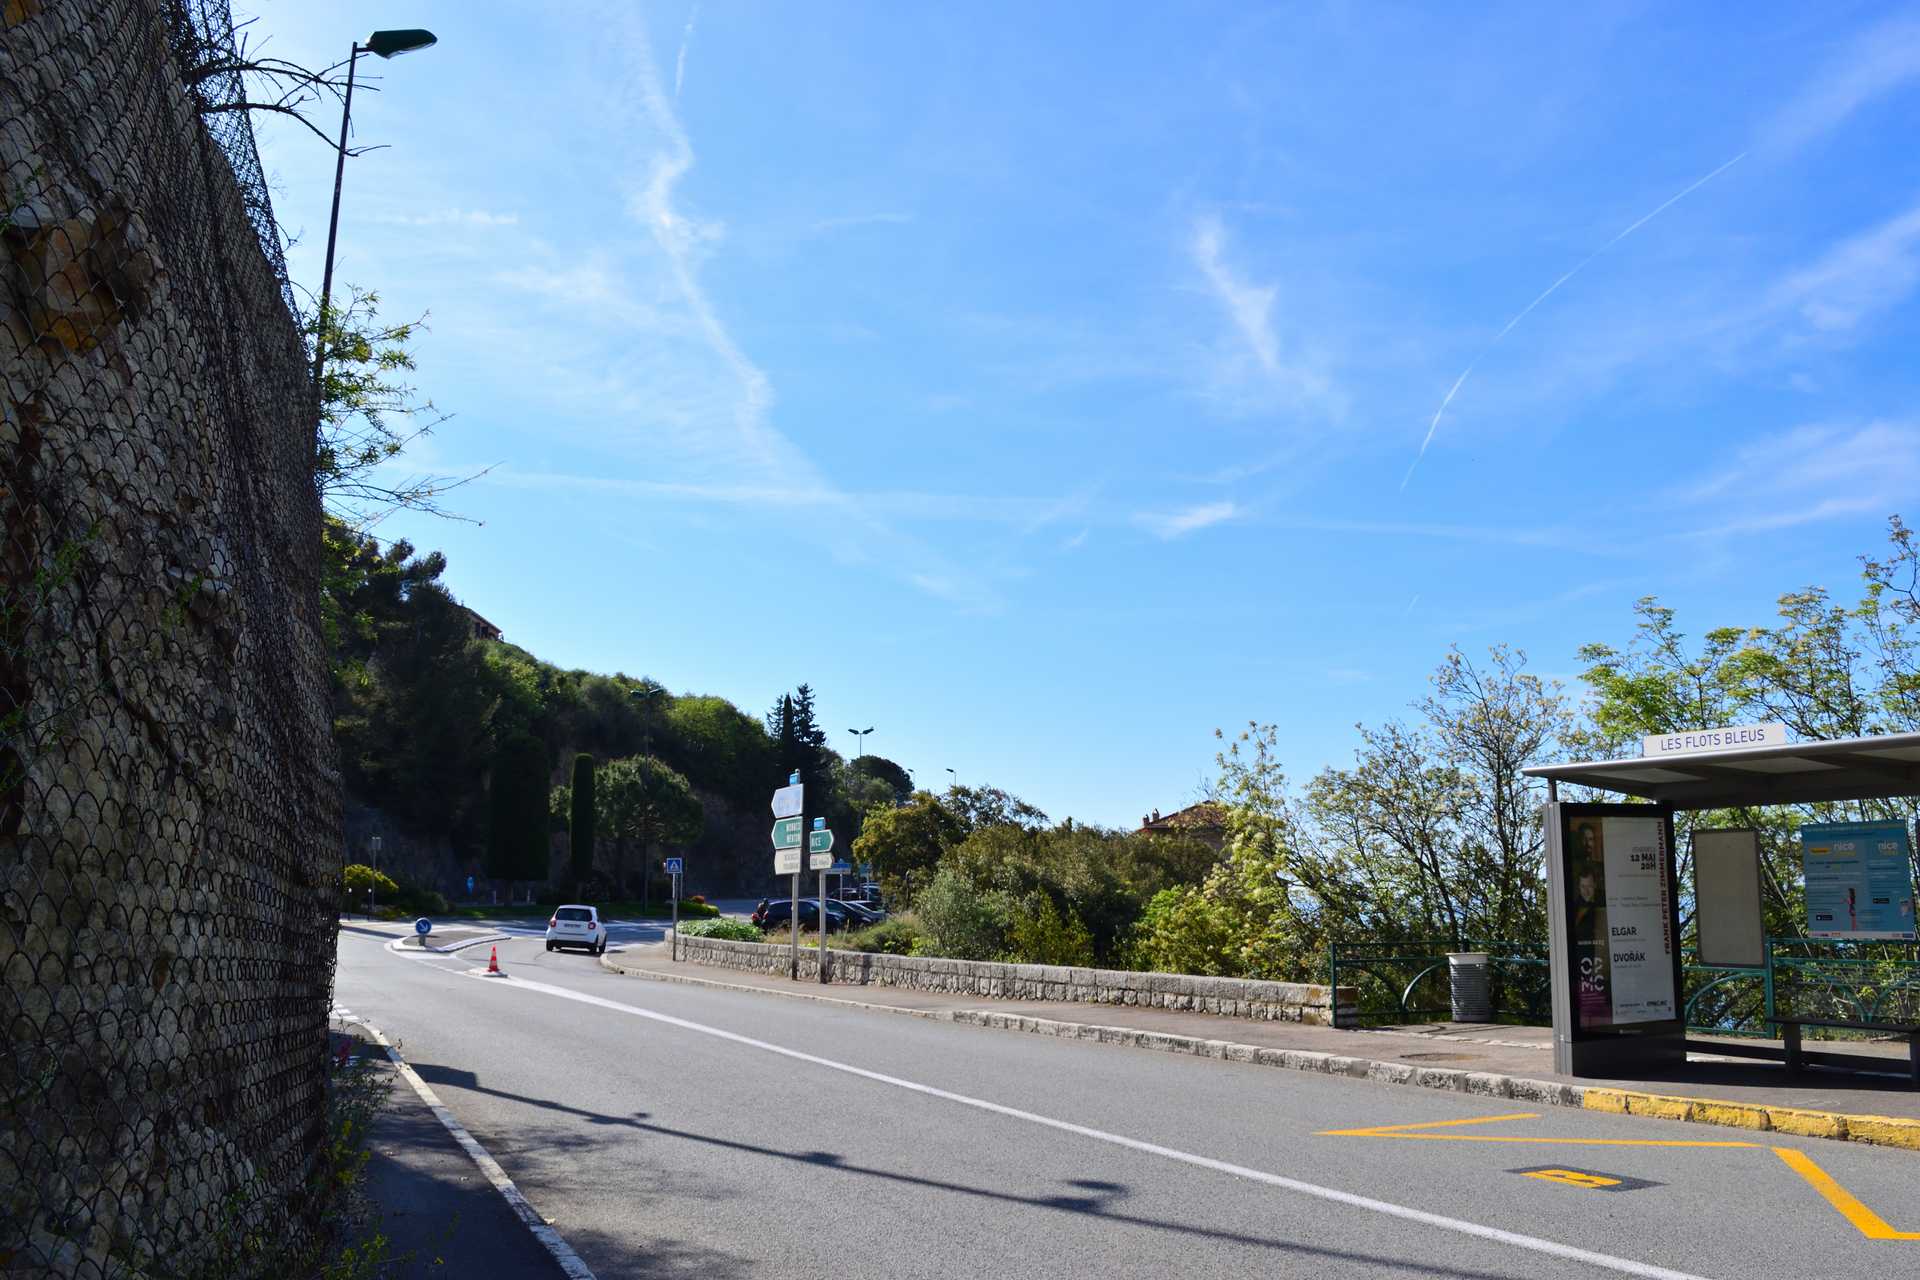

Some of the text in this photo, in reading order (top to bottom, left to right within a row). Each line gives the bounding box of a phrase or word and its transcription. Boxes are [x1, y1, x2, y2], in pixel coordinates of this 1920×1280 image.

[1661, 729, 1765, 751] LES FLOTS BLEUS
[1641, 852, 1656, 861] MAI
[1661, 890, 1669, 920] PETER
[1611, 926, 1637, 936] ELGAR
[1663, 923, 1671, 954] FRANK
